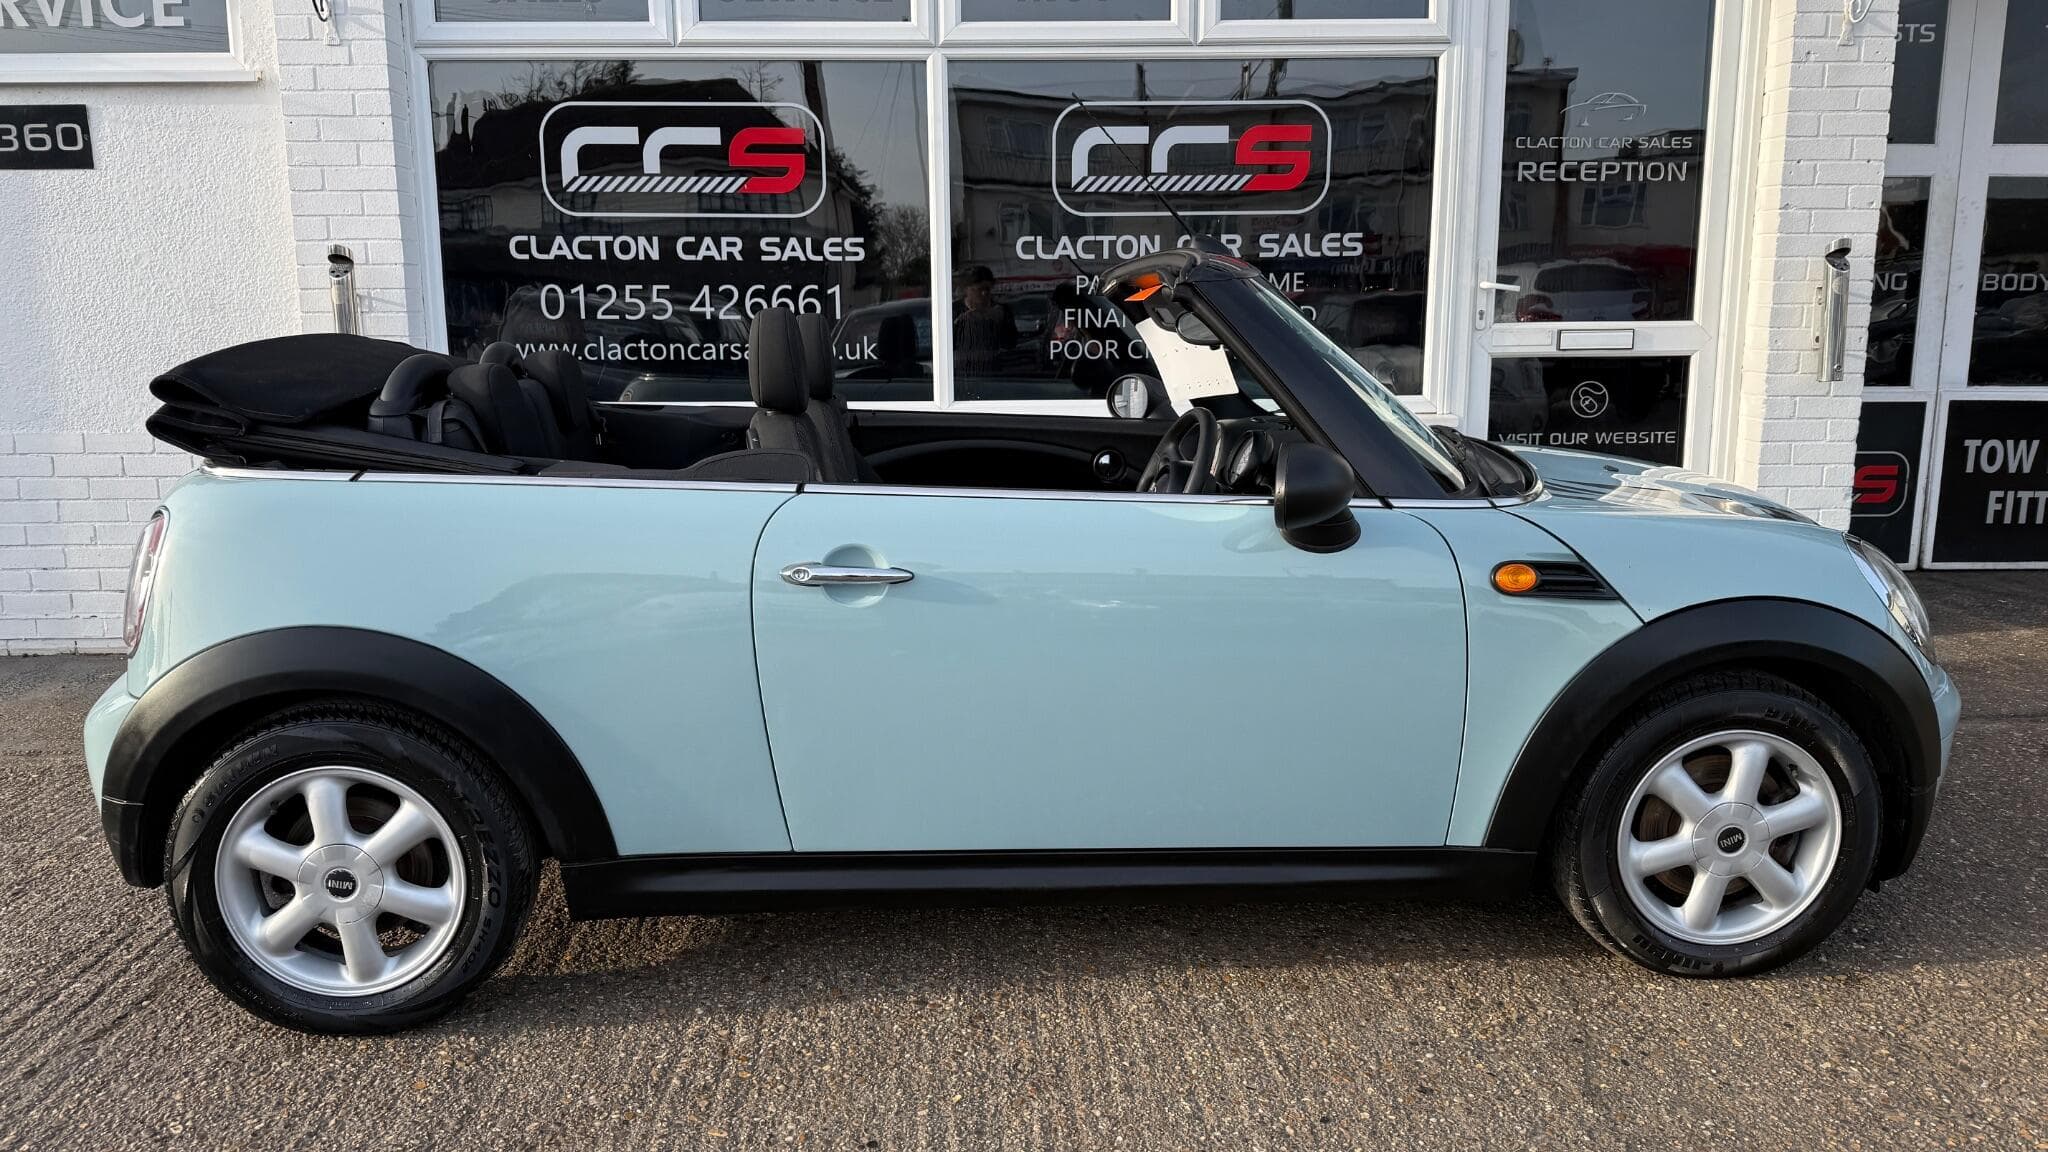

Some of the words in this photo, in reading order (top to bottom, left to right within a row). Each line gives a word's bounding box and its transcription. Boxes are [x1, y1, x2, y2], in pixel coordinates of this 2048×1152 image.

[1515, 136, 1592, 149] CLACTON
[1599, 136, 1633, 149] CAR
[1638, 136, 1694, 149] SALES
[1517, 161, 1688, 182] RECEPTION
[509, 235, 660, 261] CLACTON
[676, 236, 744, 262] CAR
[760, 236, 866, 262] SALES
[1015, 234, 1161, 260] CLACTON
[1258, 233, 1364, 258] SALES
[540, 283, 673, 321] 01255
[689, 283, 842, 321] 426661
[1050, 339, 1120, 360] POOR
[1498, 432, 1543, 446] VISIT
[1550, 432, 1589, 445] OUR
[1595, 431, 1677, 445] WEBSITE
[1964, 439, 2041, 474] TOW
[1719, 832, 1744, 848] MINI
[328, 879, 353, 891] MINI
